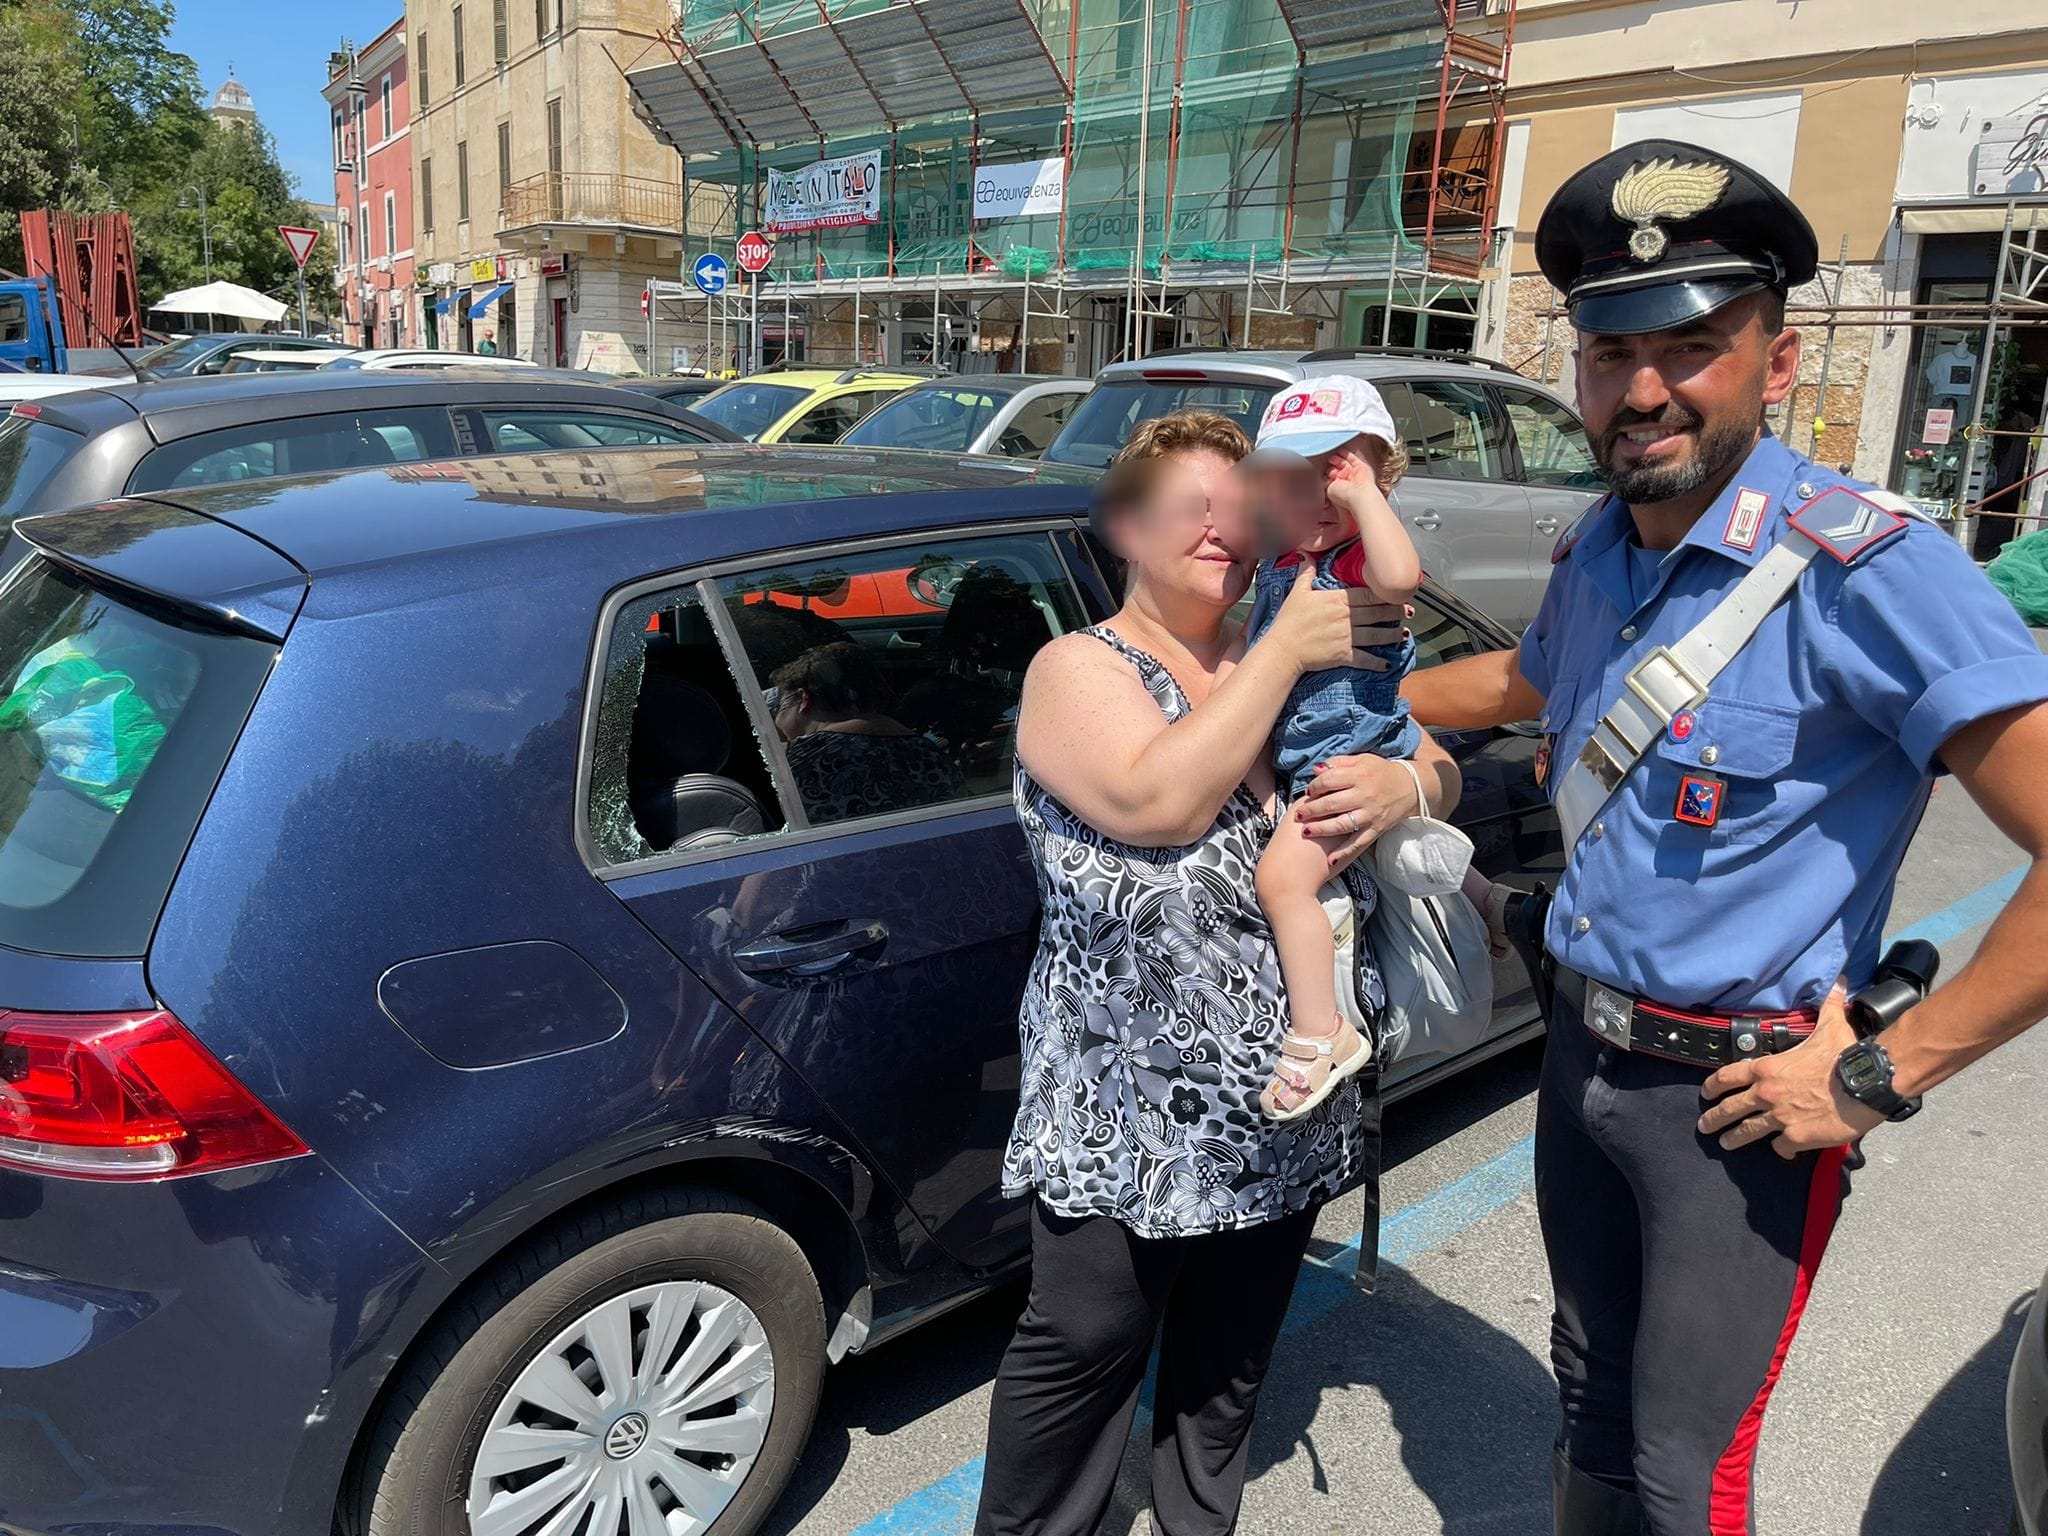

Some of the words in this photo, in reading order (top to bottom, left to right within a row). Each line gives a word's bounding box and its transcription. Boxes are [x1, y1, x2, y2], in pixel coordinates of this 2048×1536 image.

[769, 176, 804, 208] MADE
[806, 175, 822, 205] IN
[827, 162, 877, 202] ITALO
[739, 244, 769, 260] STOP
